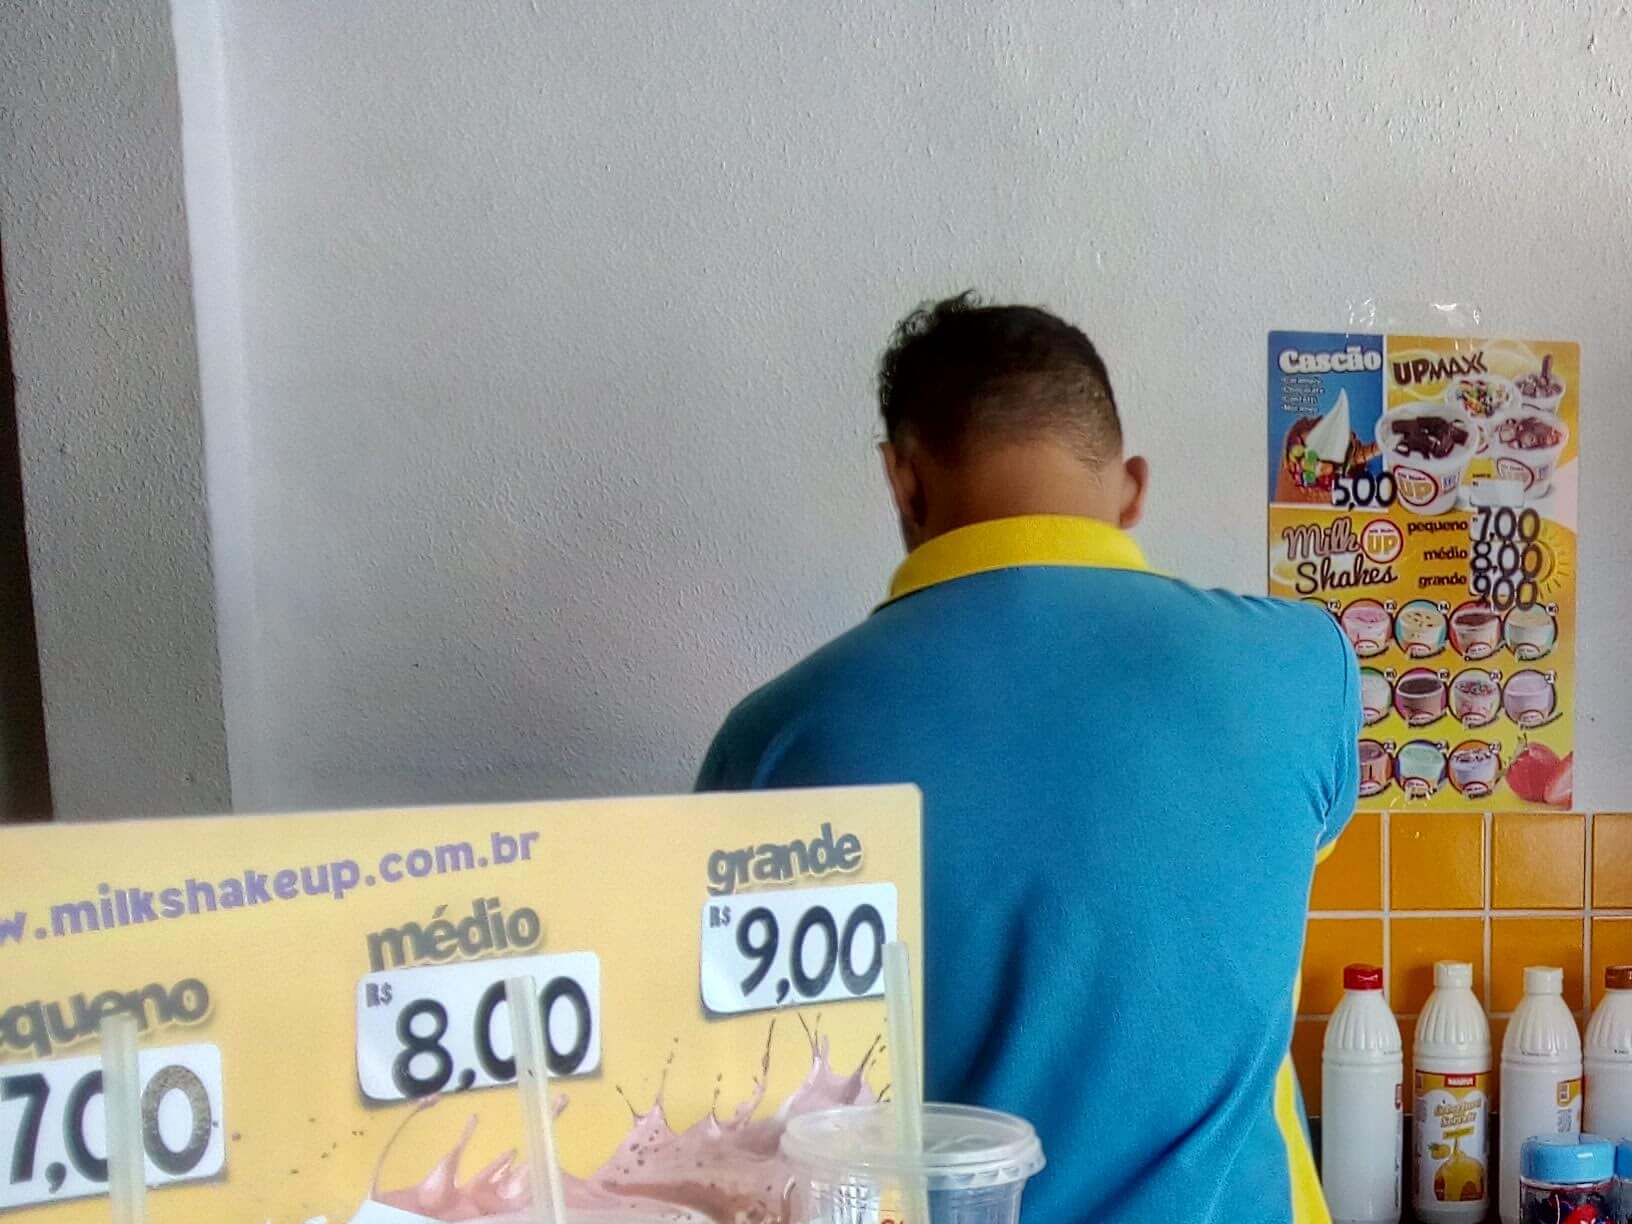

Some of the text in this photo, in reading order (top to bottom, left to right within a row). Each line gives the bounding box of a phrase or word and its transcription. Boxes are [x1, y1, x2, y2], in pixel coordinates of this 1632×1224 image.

[1279, 347, 1383, 374] Cascão
[1333, 471, 1398, 509] 5,00
[1283, 517, 1360, 560] Milk
[1408, 520, 1468, 535] pequeno
[1476, 507, 1540, 544] 7,00
[1424, 546, 1468, 562] médio
[1295, 553, 1398, 595] Shakes
[1418, 574, 1468, 588] grande
[707, 822, 862, 897] grande
[366, 902, 542, 973] médio
[708, 902, 886, 1006] R$ 9,00
[366, 981, 392, 1007] R$
[0, 978, 210, 1056] queno
